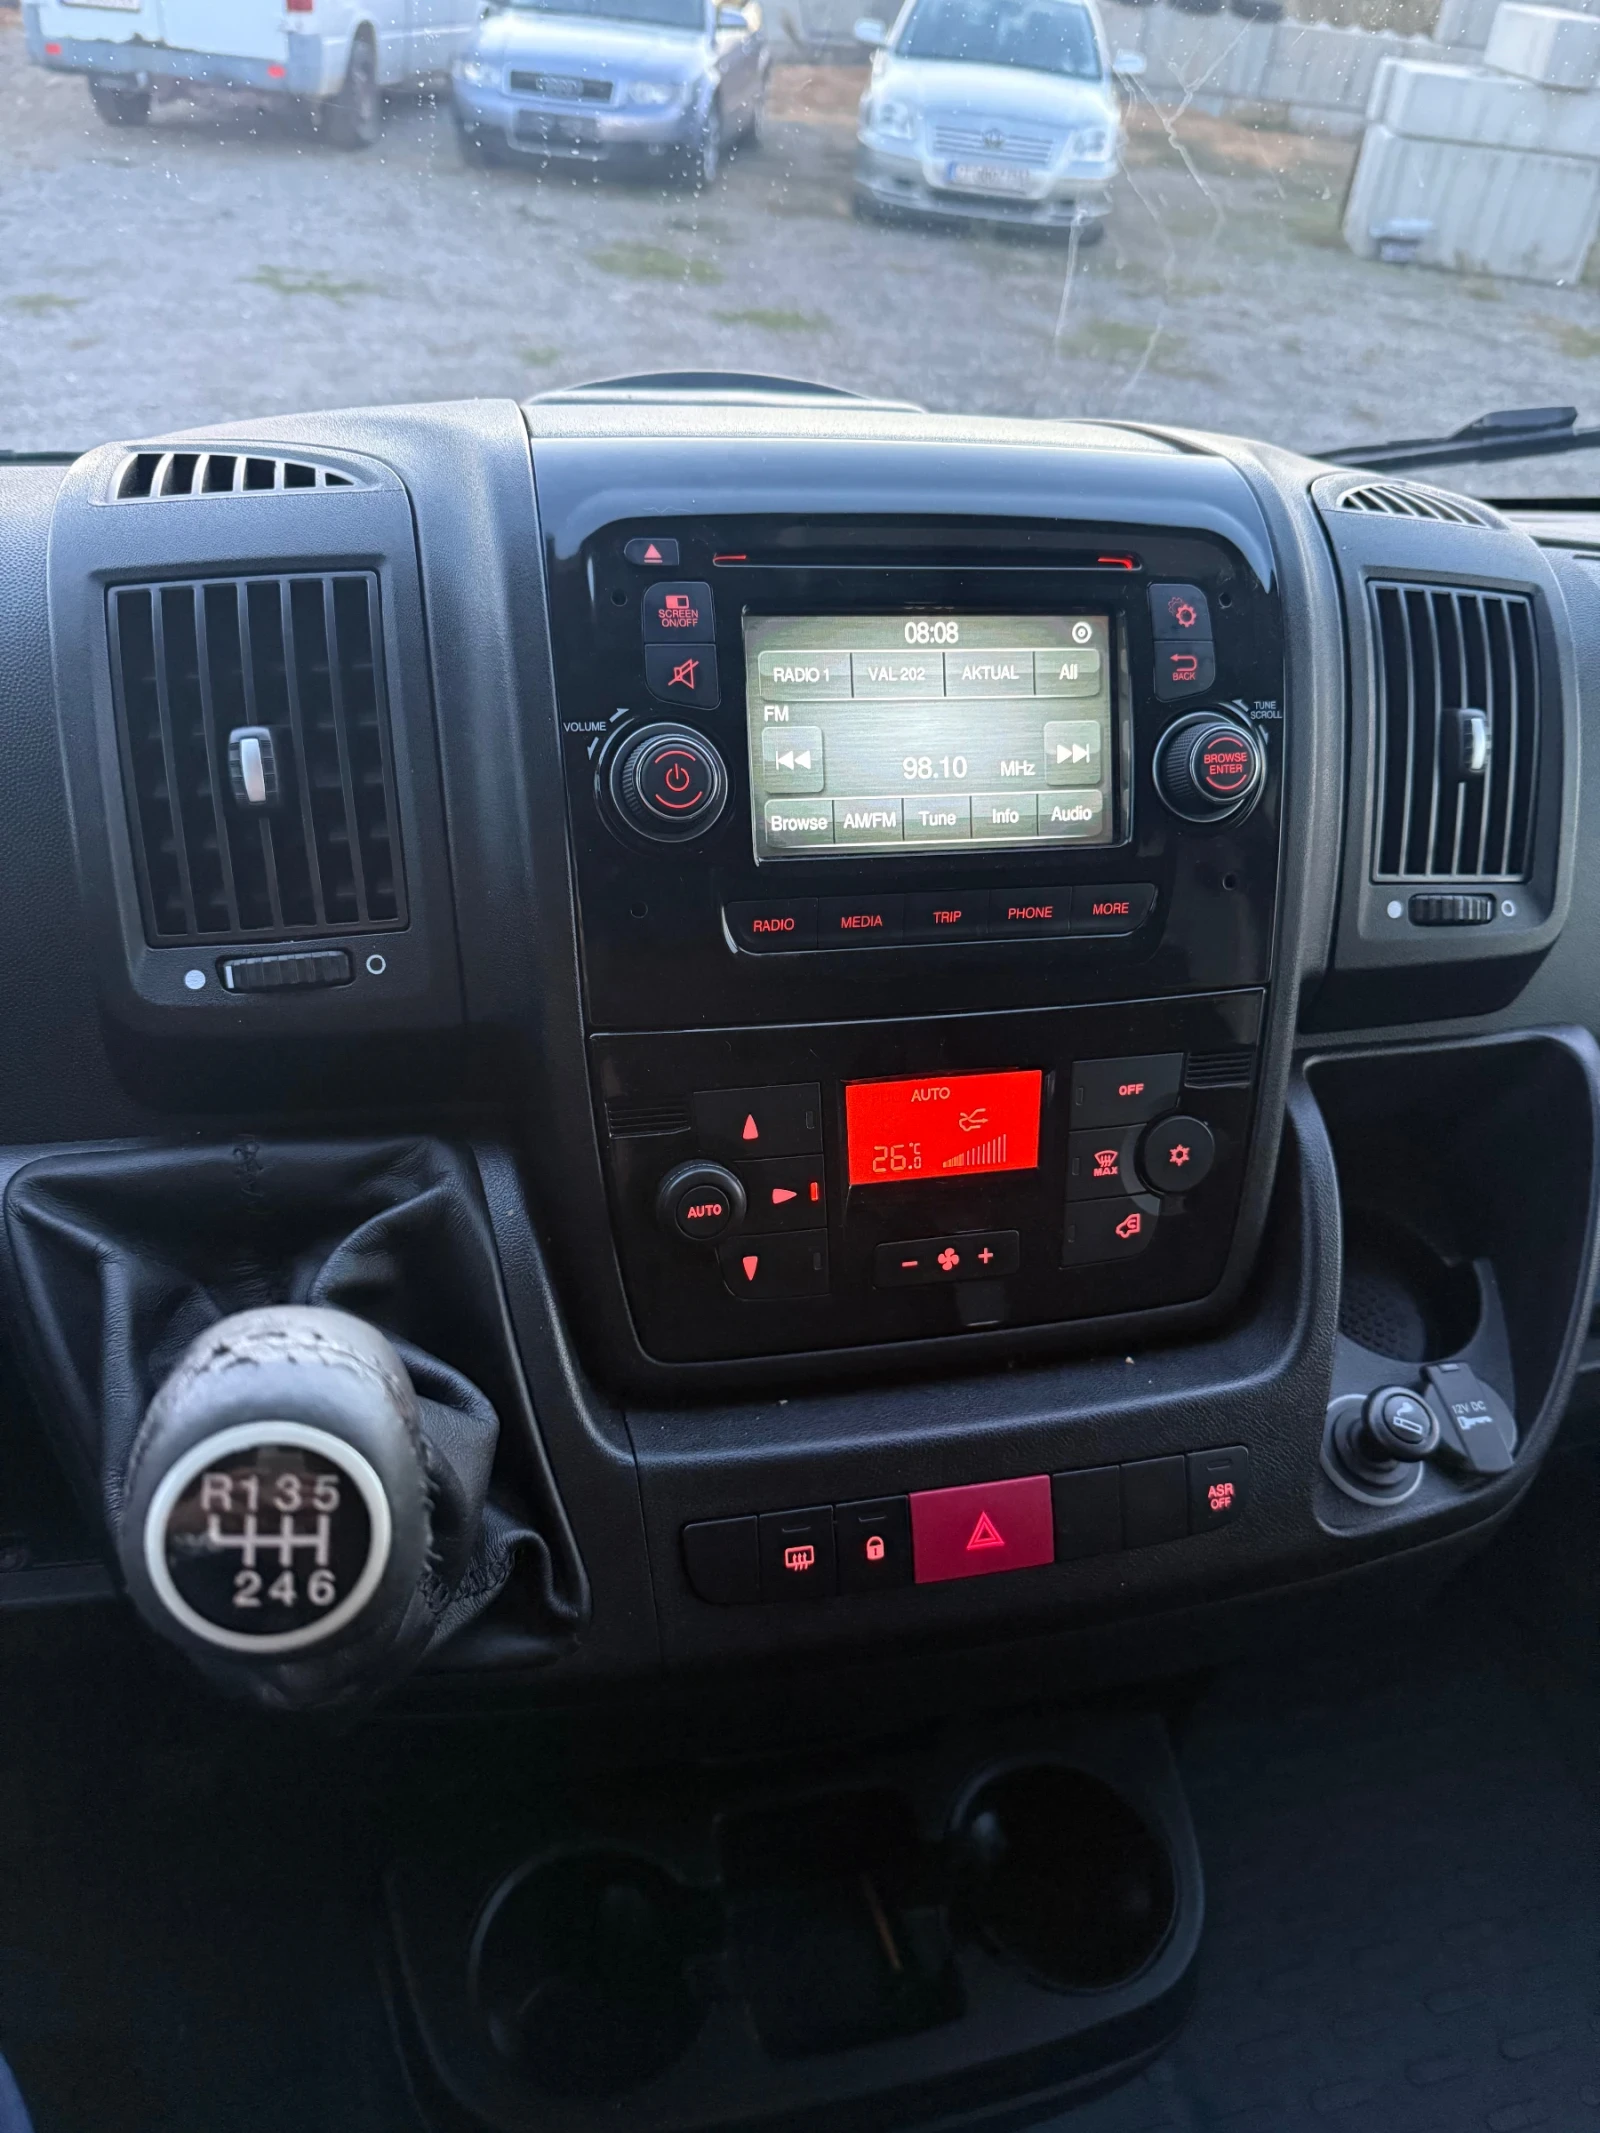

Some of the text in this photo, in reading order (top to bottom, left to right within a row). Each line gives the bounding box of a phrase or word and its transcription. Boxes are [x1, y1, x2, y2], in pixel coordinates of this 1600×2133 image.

[658, 609, 698, 619] SCREEN
[661, 618, 698, 628] ON/OFF
[904, 621, 959, 644] 08:08
[773, 668, 830, 683] RADIO 1
[867, 667, 925, 681] VAL 202
[961, 665, 1020, 680] AKTUAL
[1059, 664, 1078, 680] All
[1172, 671, 1196, 681] BACK
[1253, 701, 1277, 710] TUNE
[764, 706, 789, 721] FM
[1250, 710, 1282, 720] SCROLL
[563, 721, 607, 732] VOLUME
[1203, 752, 1248, 764] BROWSE
[902, 756, 967, 779] 98.10
[1000, 760, 1036, 777] MHz
[1209, 763, 1243, 775] ENTER
[843, 812, 897, 828] AM/FM
[918, 811, 957, 826] Tune
[992, 808, 1020, 824] Info
[1051, 805, 1093, 822] Audio
[771, 815, 828, 831] Browse
[1007, 906, 1054, 920] PHONE
[1092, 902, 1130, 915] MORE
[753, 918, 795, 932] RADIO
[840, 914, 883, 929] MEDIA
[933, 911, 962, 924] TRIP
[910, 1086, 951, 1102] AUTO
[1118, 1083, 1145, 1096] OFF
[1093, 1166, 1119, 1177] MAX
[687, 1203, 723, 1219] AUTO
[1451, 1400, 1487, 1415] 12V DC
[1208, 1482, 1235, 1498] ASR
[1210, 1496, 1232, 1510] OFF
